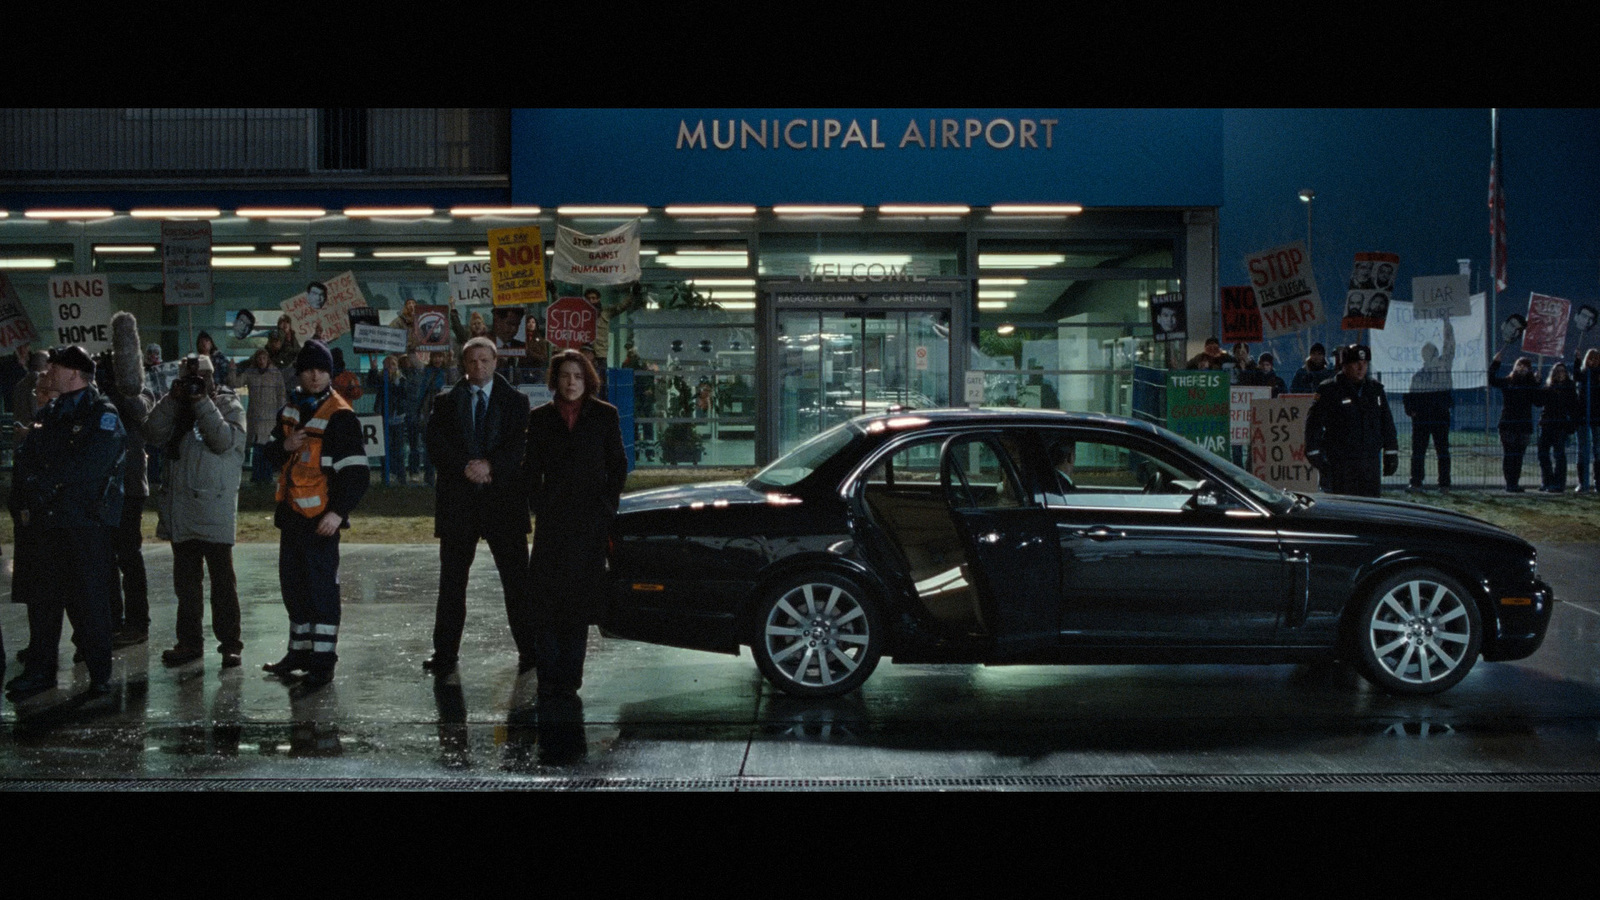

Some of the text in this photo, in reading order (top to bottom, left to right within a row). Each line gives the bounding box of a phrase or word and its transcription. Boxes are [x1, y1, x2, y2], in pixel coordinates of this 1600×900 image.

[675, 118, 1059, 150] MUNICIPAL AIRPORT
[572, 235, 626, 246] STOP CRIMES
[497, 244, 541, 268] NO!
[453, 262, 491, 275] LANG
[795, 262, 927, 282] WELCOME
[1249, 248, 1302, 287] STOP
[52, 279, 104, 298] LANG
[458, 287, 491, 300] LIAR
[1258, 287, 1277, 302] THE
[1423, 286, 1454, 303] LIAR
[777, 294, 937, 303] BAGGAGE CLAIM CAR RENTAL
[1224, 288, 1257, 310] NO
[59, 303, 81, 320] GO
[549, 309, 592, 329] STOP
[1263, 299, 1316, 330] WAR
[1223, 312, 1260, 334] WAR
[58, 324, 108, 344] HOME
[549, 329, 592, 342] TORTURE
[1208, 375, 1220, 387] IS
[1231, 392, 1254, 404] EXIT
[1196, 435, 1226, 452] WAR
